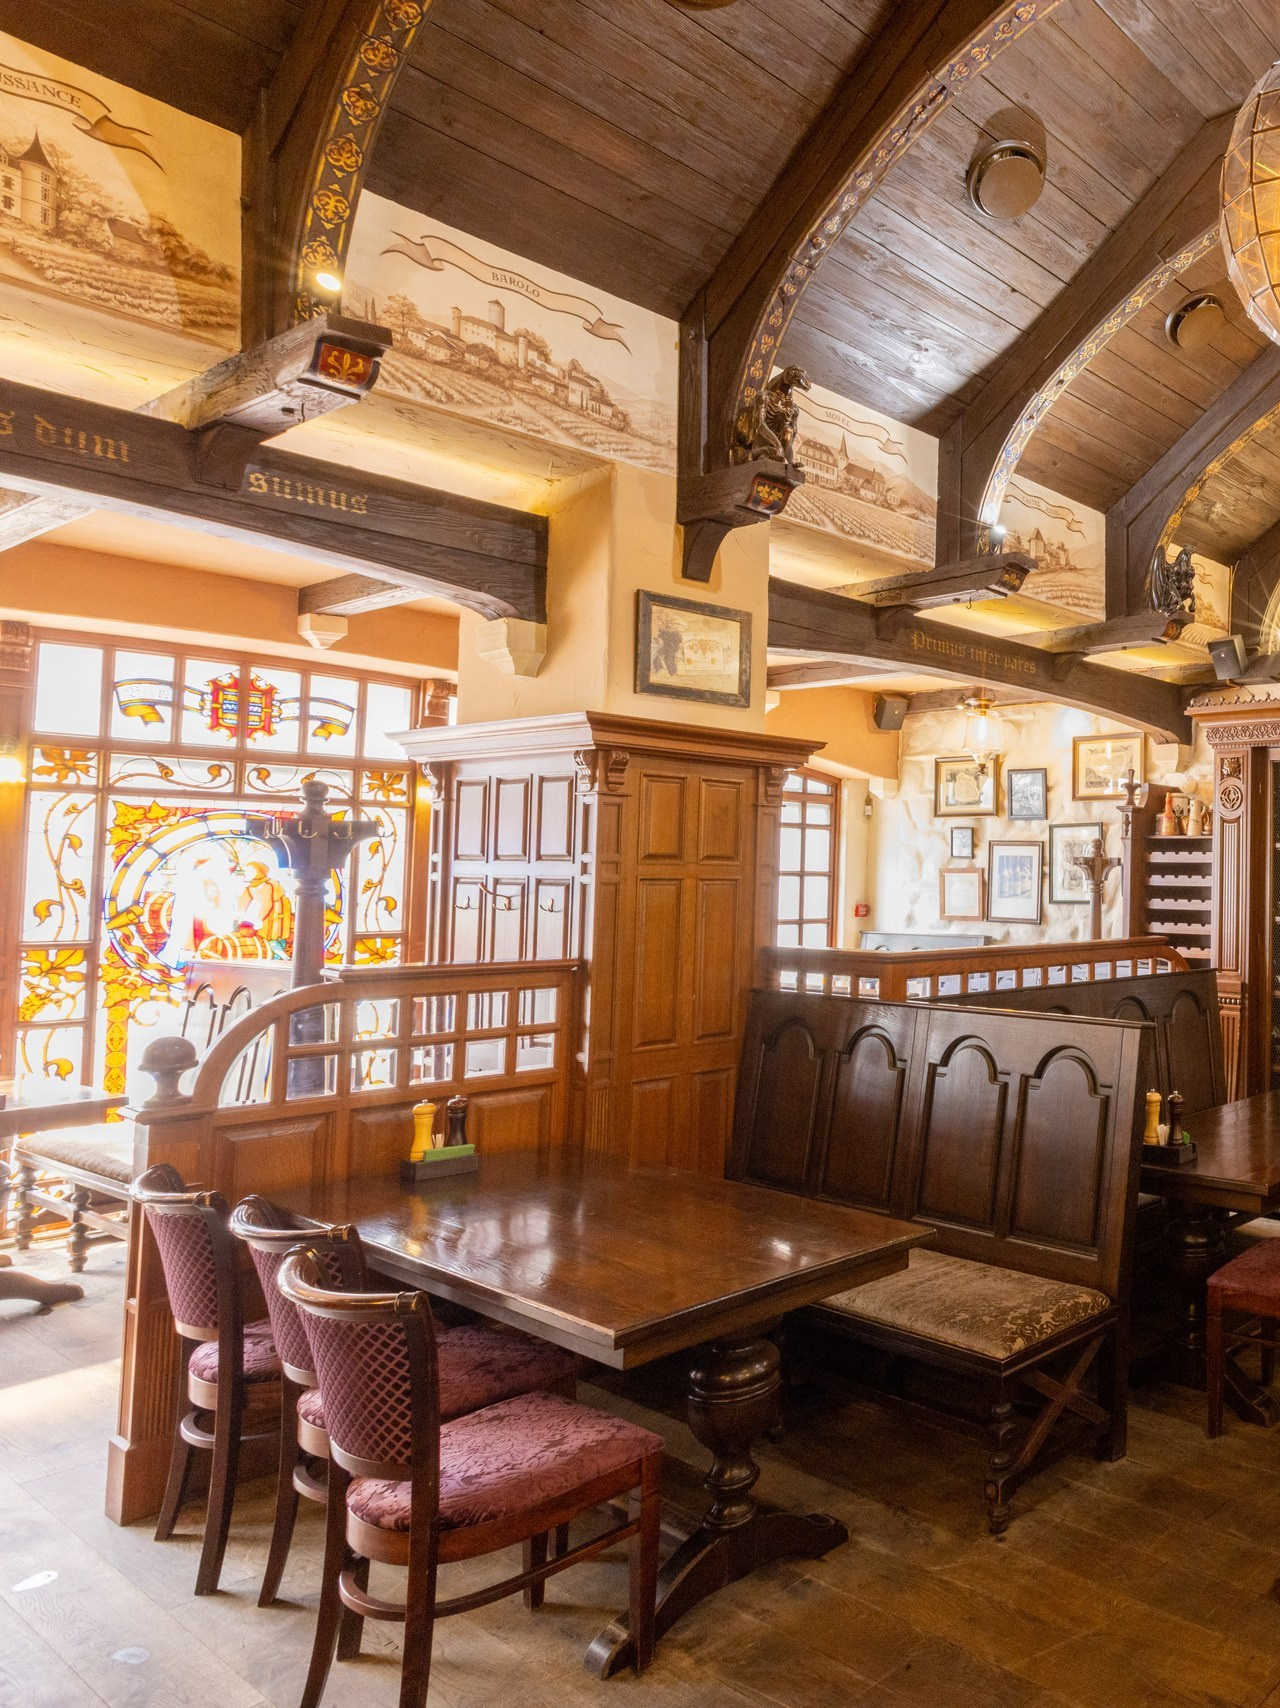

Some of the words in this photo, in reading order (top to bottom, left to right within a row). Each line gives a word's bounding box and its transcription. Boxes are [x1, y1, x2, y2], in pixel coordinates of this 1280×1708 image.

[491, 272, 540, 298] BAROLO
[825, 411, 851, 428] MOSEL
[34, 414, 130, 462] dum
[1022, 495, 1041, 508] CASTEL
[911, 630, 967, 658] Primus
[971, 647, 1001, 666] inter
[1004, 655, 1037, 674] pares
